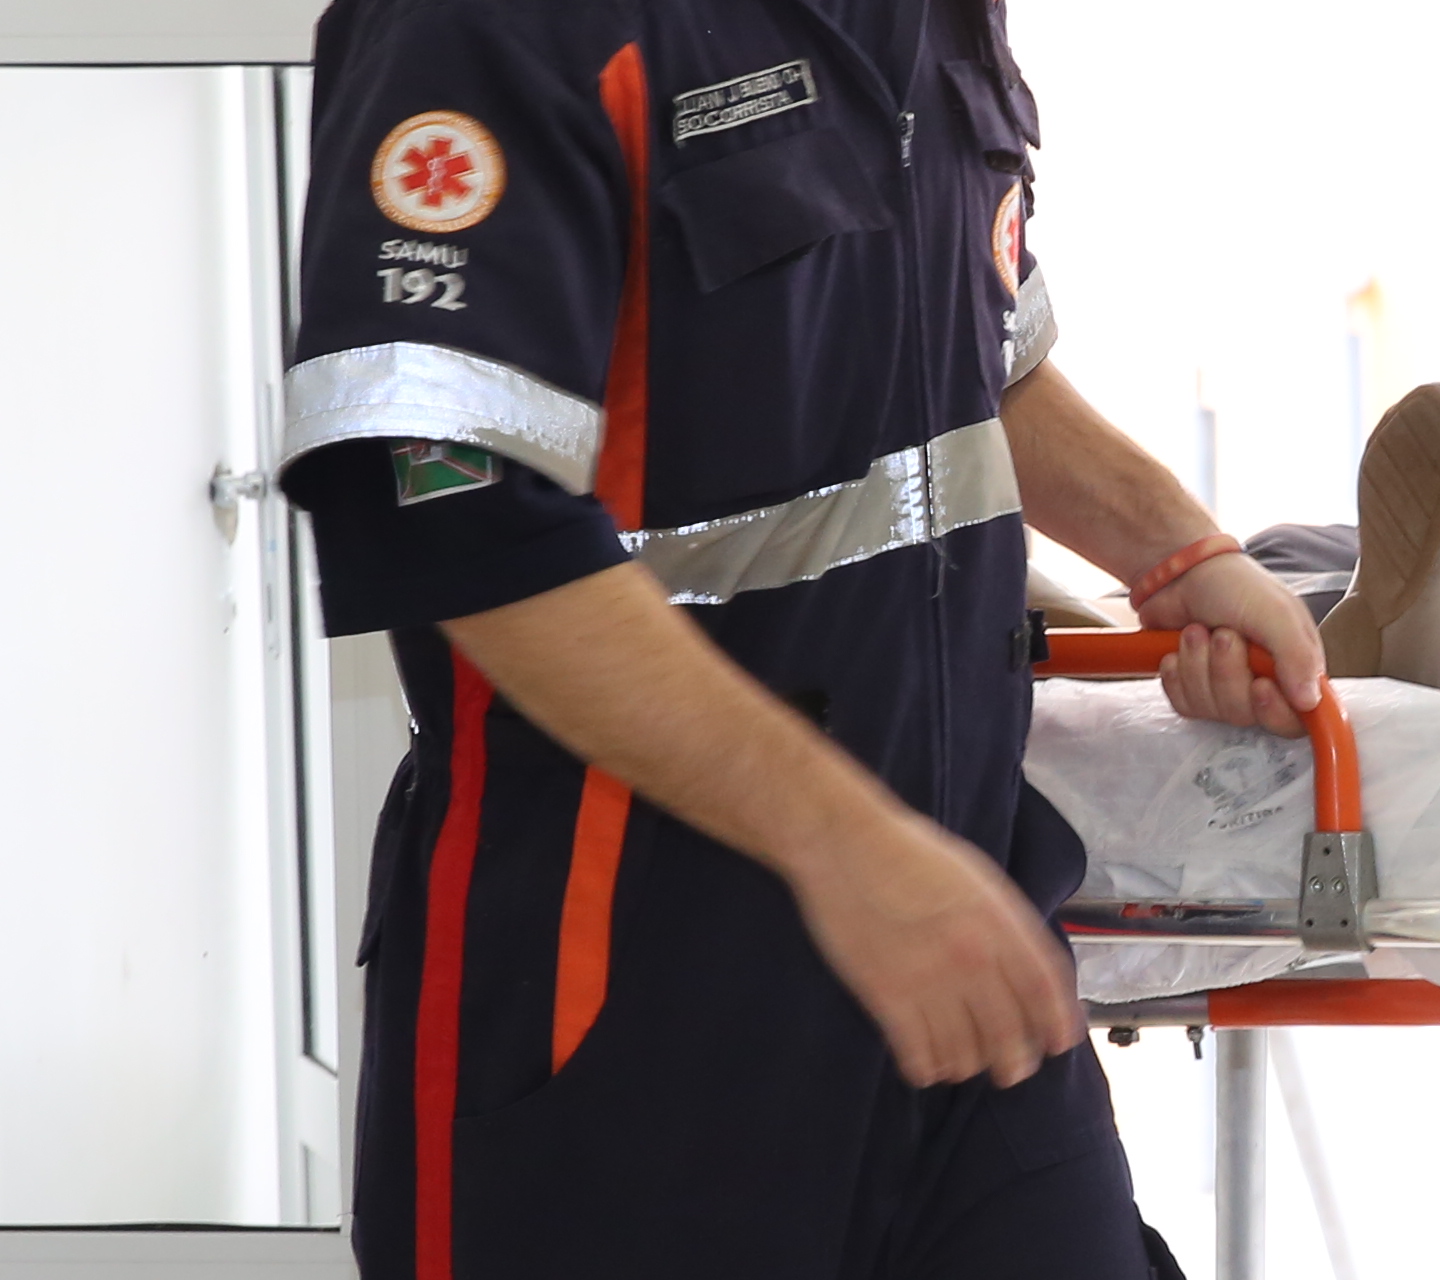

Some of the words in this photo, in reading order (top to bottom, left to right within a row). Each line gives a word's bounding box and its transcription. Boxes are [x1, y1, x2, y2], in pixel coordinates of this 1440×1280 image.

[677, 90, 793, 133] SOCORRISTA
[378, 239, 469, 268] SAMU
[376, 267, 468, 311] 192
